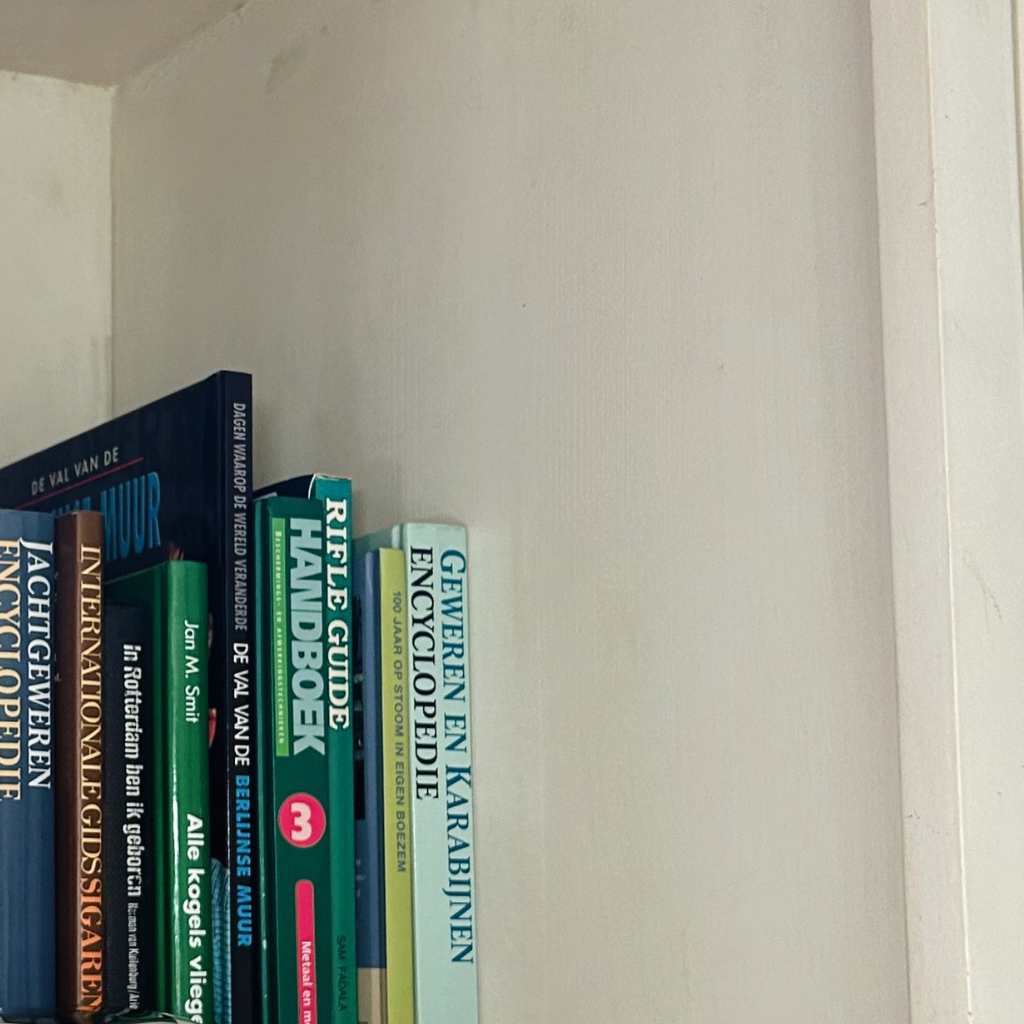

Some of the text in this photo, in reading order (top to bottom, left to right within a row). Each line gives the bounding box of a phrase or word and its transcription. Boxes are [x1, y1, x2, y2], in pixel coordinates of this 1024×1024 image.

[31, 447, 119, 496] DE VAL VAN DE
[100, 471, 161, 563] MUUR
[123, 644, 141, 662] in
[289, 517, 326, 756] HANDBOEK
[326, 498, 350, 730] RIFLE GUIDE
[20, 538, 54, 790] JACHTGEWEREN
[184, 620, 199, 724] Jan M. Smit
[233, 403, 253, 947] DAGEN WAAROP DE WERELD VERANDERDE DE VAL VAN DE BERLIJNSE MUUR
[410, 546, 440, 801] ENCYCLOPEDIE
[123, 666, 142, 759] Rotterdam
[392, 591, 406, 873] 100 JAAR OP STOOM IN EIGEN BOEZEM
[80, 543, 103, 1011] INTERNATIONALE GIDS SIGAREN
[126, 764, 143, 797] ben
[440, 548, 475, 966] GEWEREN EN KARABIJNEN
[126, 801, 144, 819] ik
[187, 814, 204, 860] Alle
[288, 804, 313, 841] 3
[123, 823, 145, 897] geboren
[183, 868, 205, 948] kogels
[301, 940, 312, 985] Metaal
[303, 990, 311, 1007] en
[337, 935, 347, 1011] SAM FADALA
